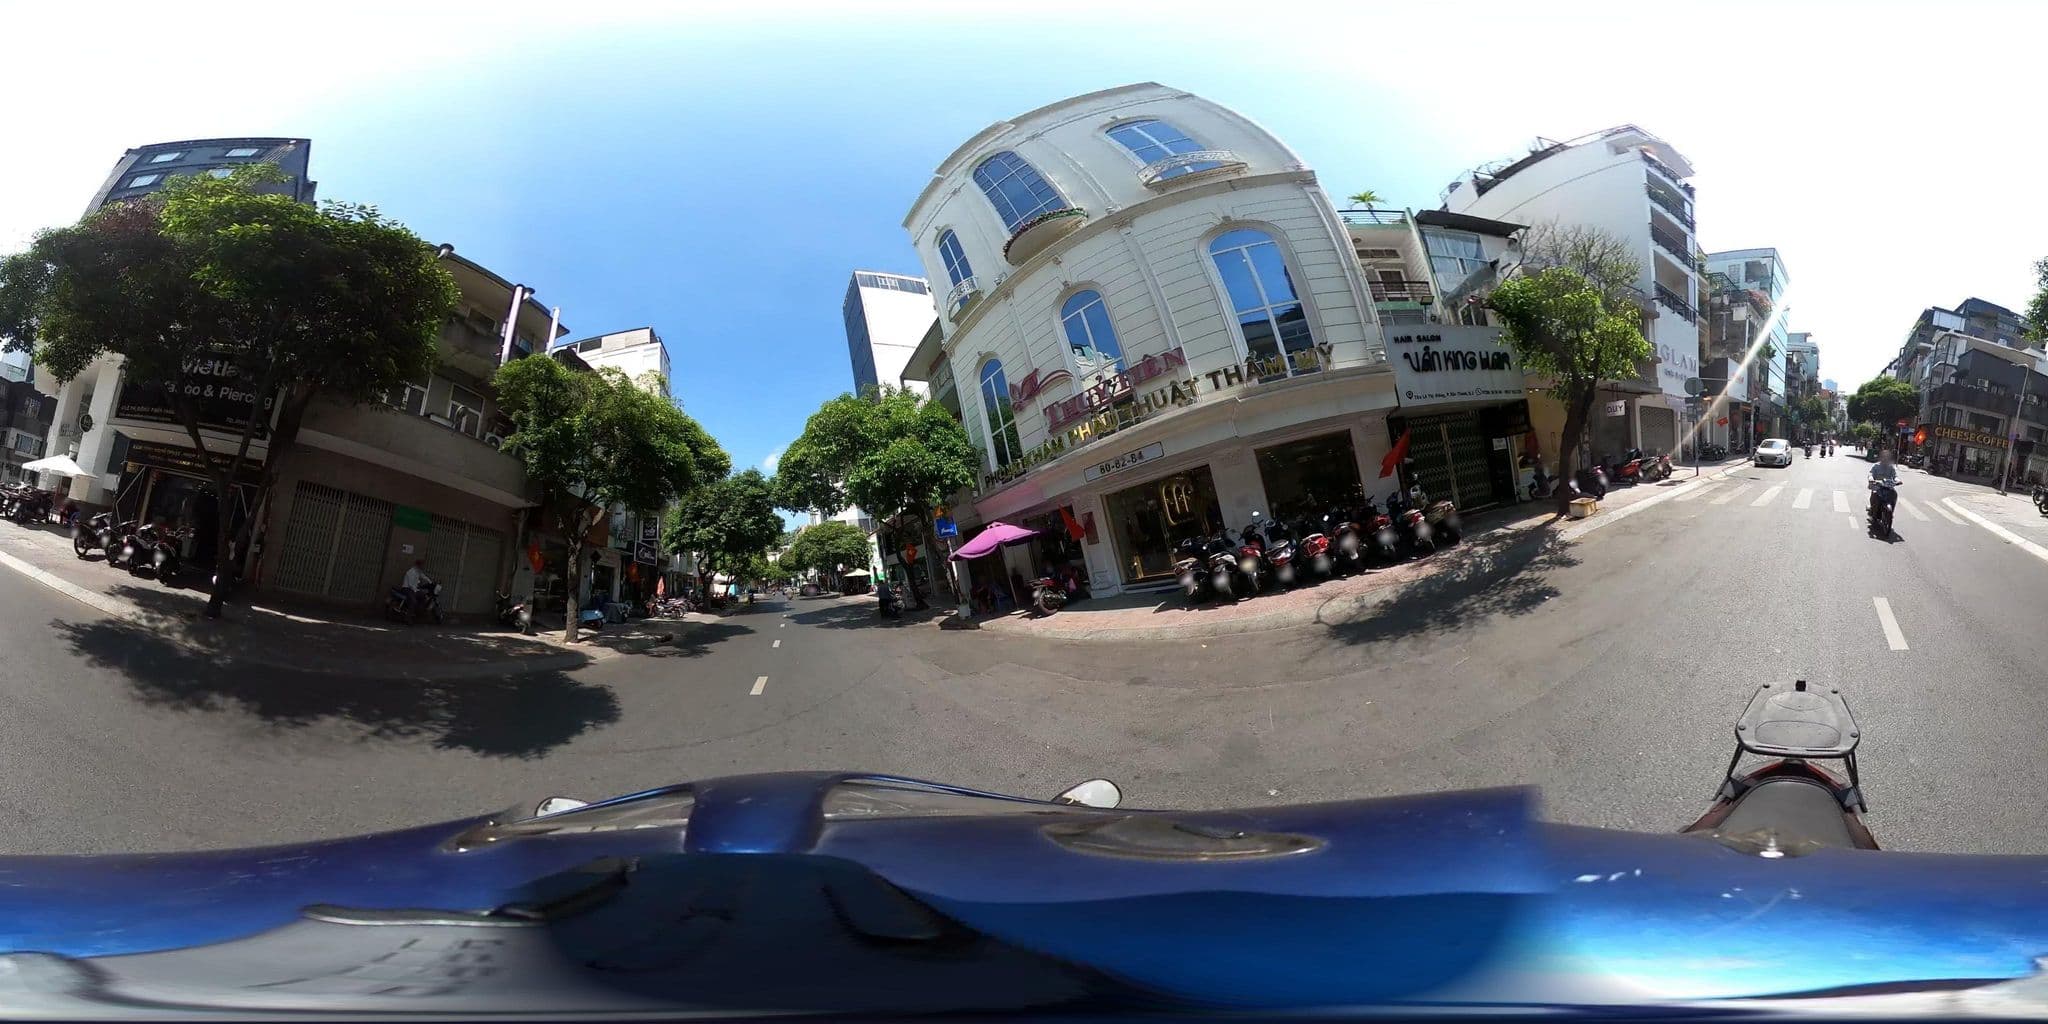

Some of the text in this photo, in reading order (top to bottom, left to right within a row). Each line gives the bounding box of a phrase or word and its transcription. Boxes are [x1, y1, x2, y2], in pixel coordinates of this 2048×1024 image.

[1394, 334, 1441, 344] HAIR SALON
[1442, 351, 1478, 371] KING
[203, 384, 214, 398] &
[219, 386, 273, 410] Piercg
[1099, 450, 1145, 475] 80-82-84
